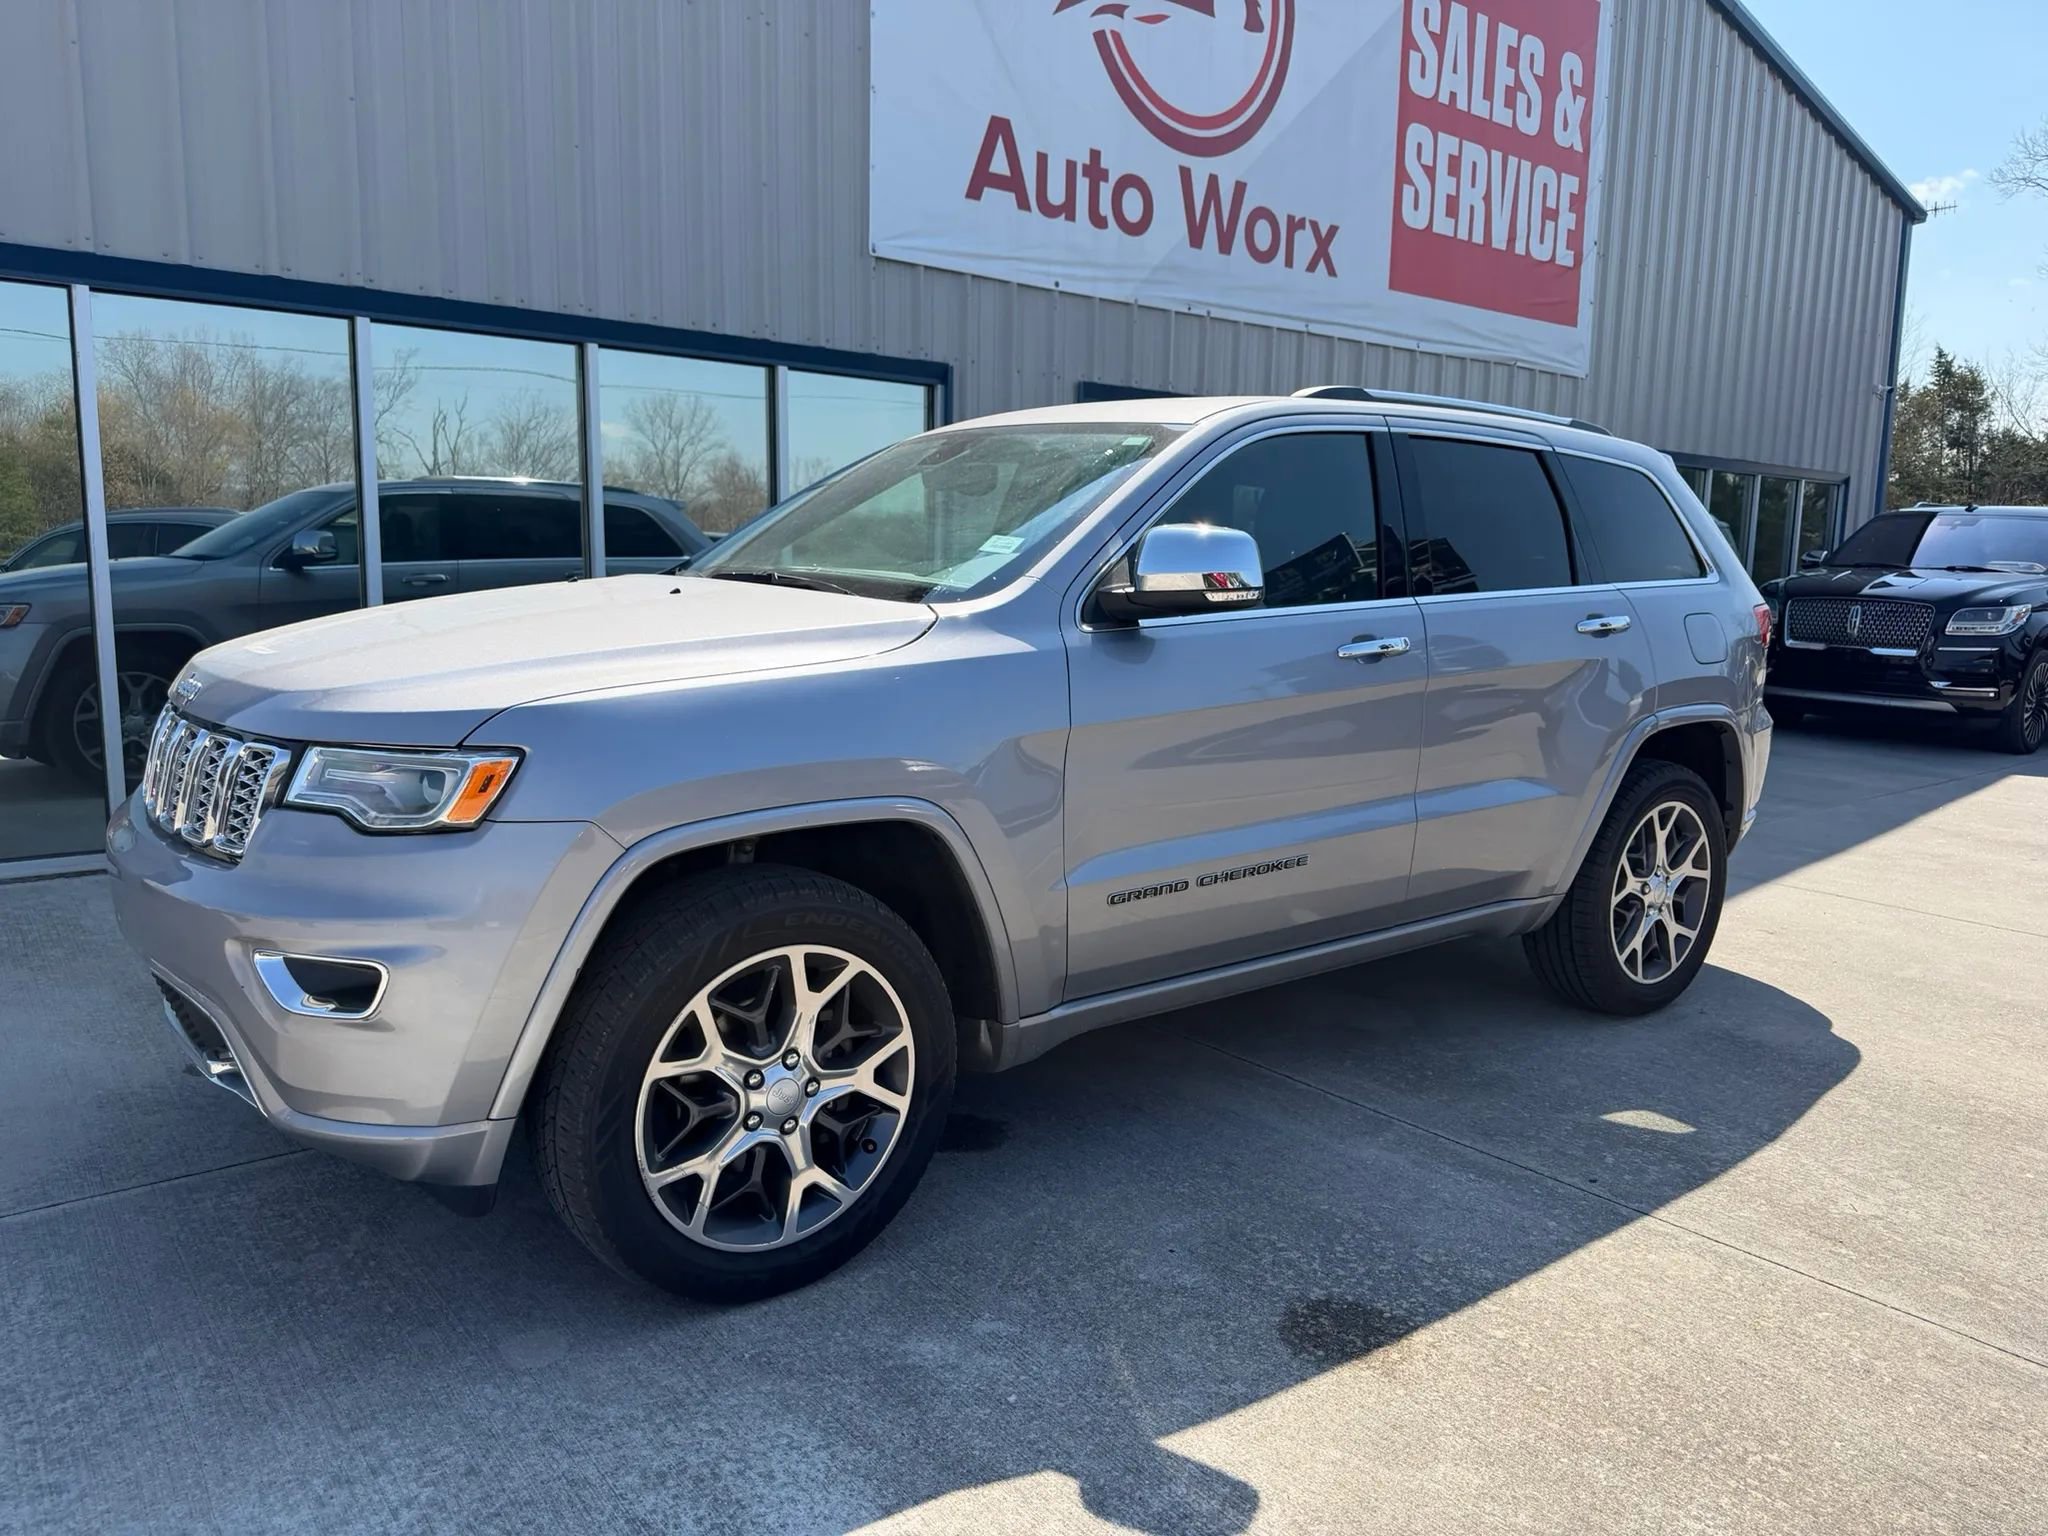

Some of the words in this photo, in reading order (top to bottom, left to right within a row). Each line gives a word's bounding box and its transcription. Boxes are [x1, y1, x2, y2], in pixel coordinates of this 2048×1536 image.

[1408, 0, 1545, 136] SALES
[1553, 51, 1587, 153] &
[965, 115, 1154, 237] Auto
[1178, 165, 1340, 278] Worx
[1401, 122, 1580, 268] SERVICE
[1107, 879, 1190, 905] GRAND
[1196, 854, 1311, 887] CHEROKEE
